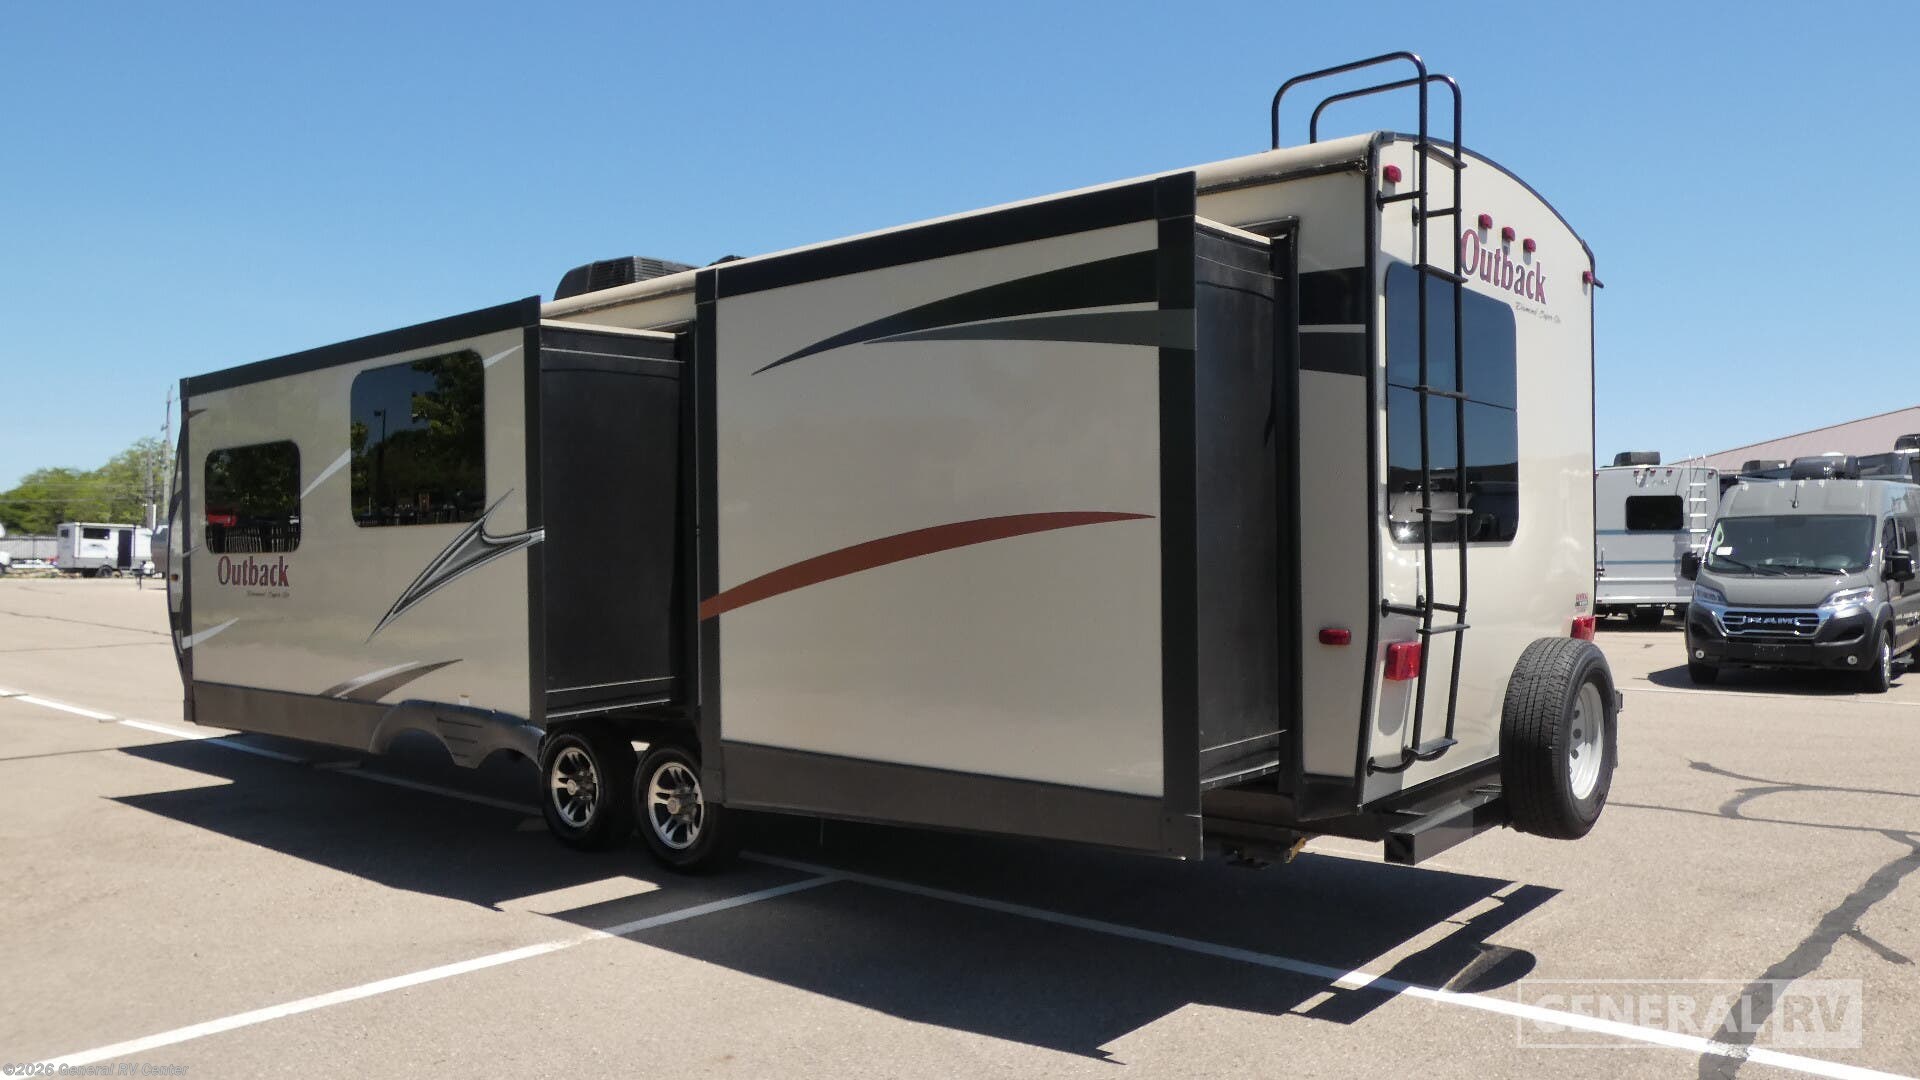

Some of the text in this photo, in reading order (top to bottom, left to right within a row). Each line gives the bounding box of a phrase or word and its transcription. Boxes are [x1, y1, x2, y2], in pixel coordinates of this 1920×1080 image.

[1460, 228, 1546, 304] Outback
[217, 555, 290, 587] Outback
[1747, 616, 1793, 625] RAM
